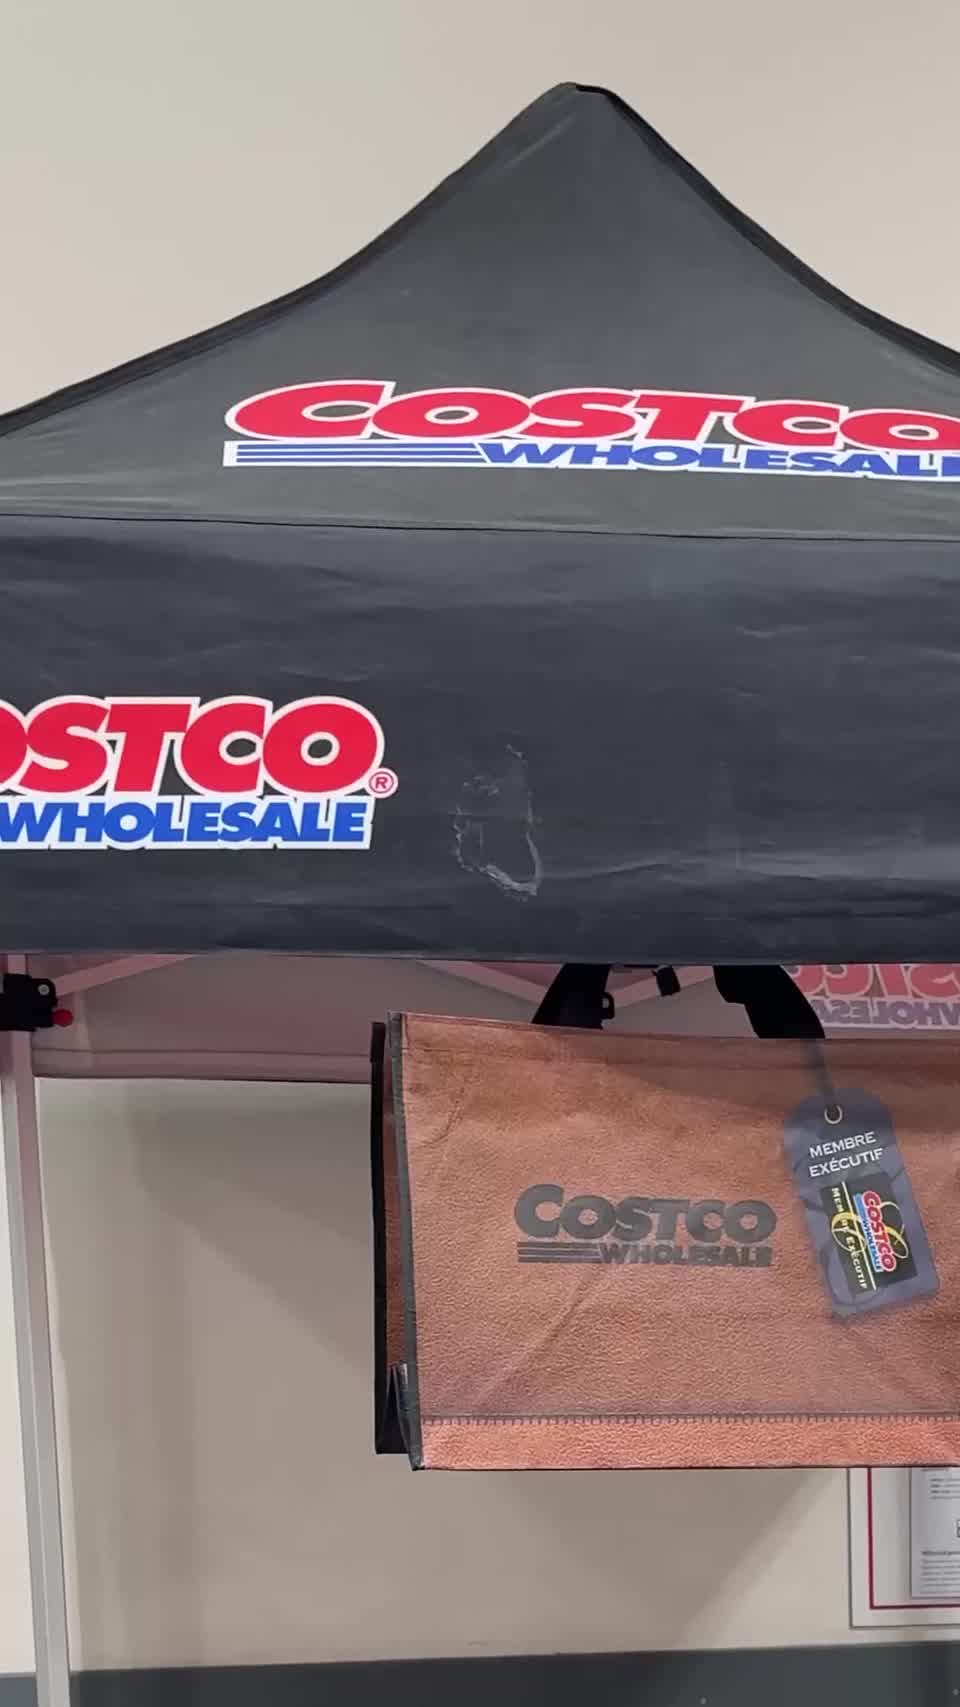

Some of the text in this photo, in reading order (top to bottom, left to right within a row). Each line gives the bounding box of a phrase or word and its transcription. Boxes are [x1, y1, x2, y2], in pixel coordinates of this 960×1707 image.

[0, 699, 379, 795] STCO
[0, 801, 368, 844] WHOLESALE
[807, 1147, 884, 1178] EXÉCUTIF
[808, 1130, 878, 1159] MEMBRE
[515, 1184, 778, 1244] COSTCO
[862, 1190, 897, 1273] COSTCO
[600, 1243, 774, 1267] WHOLESALE
